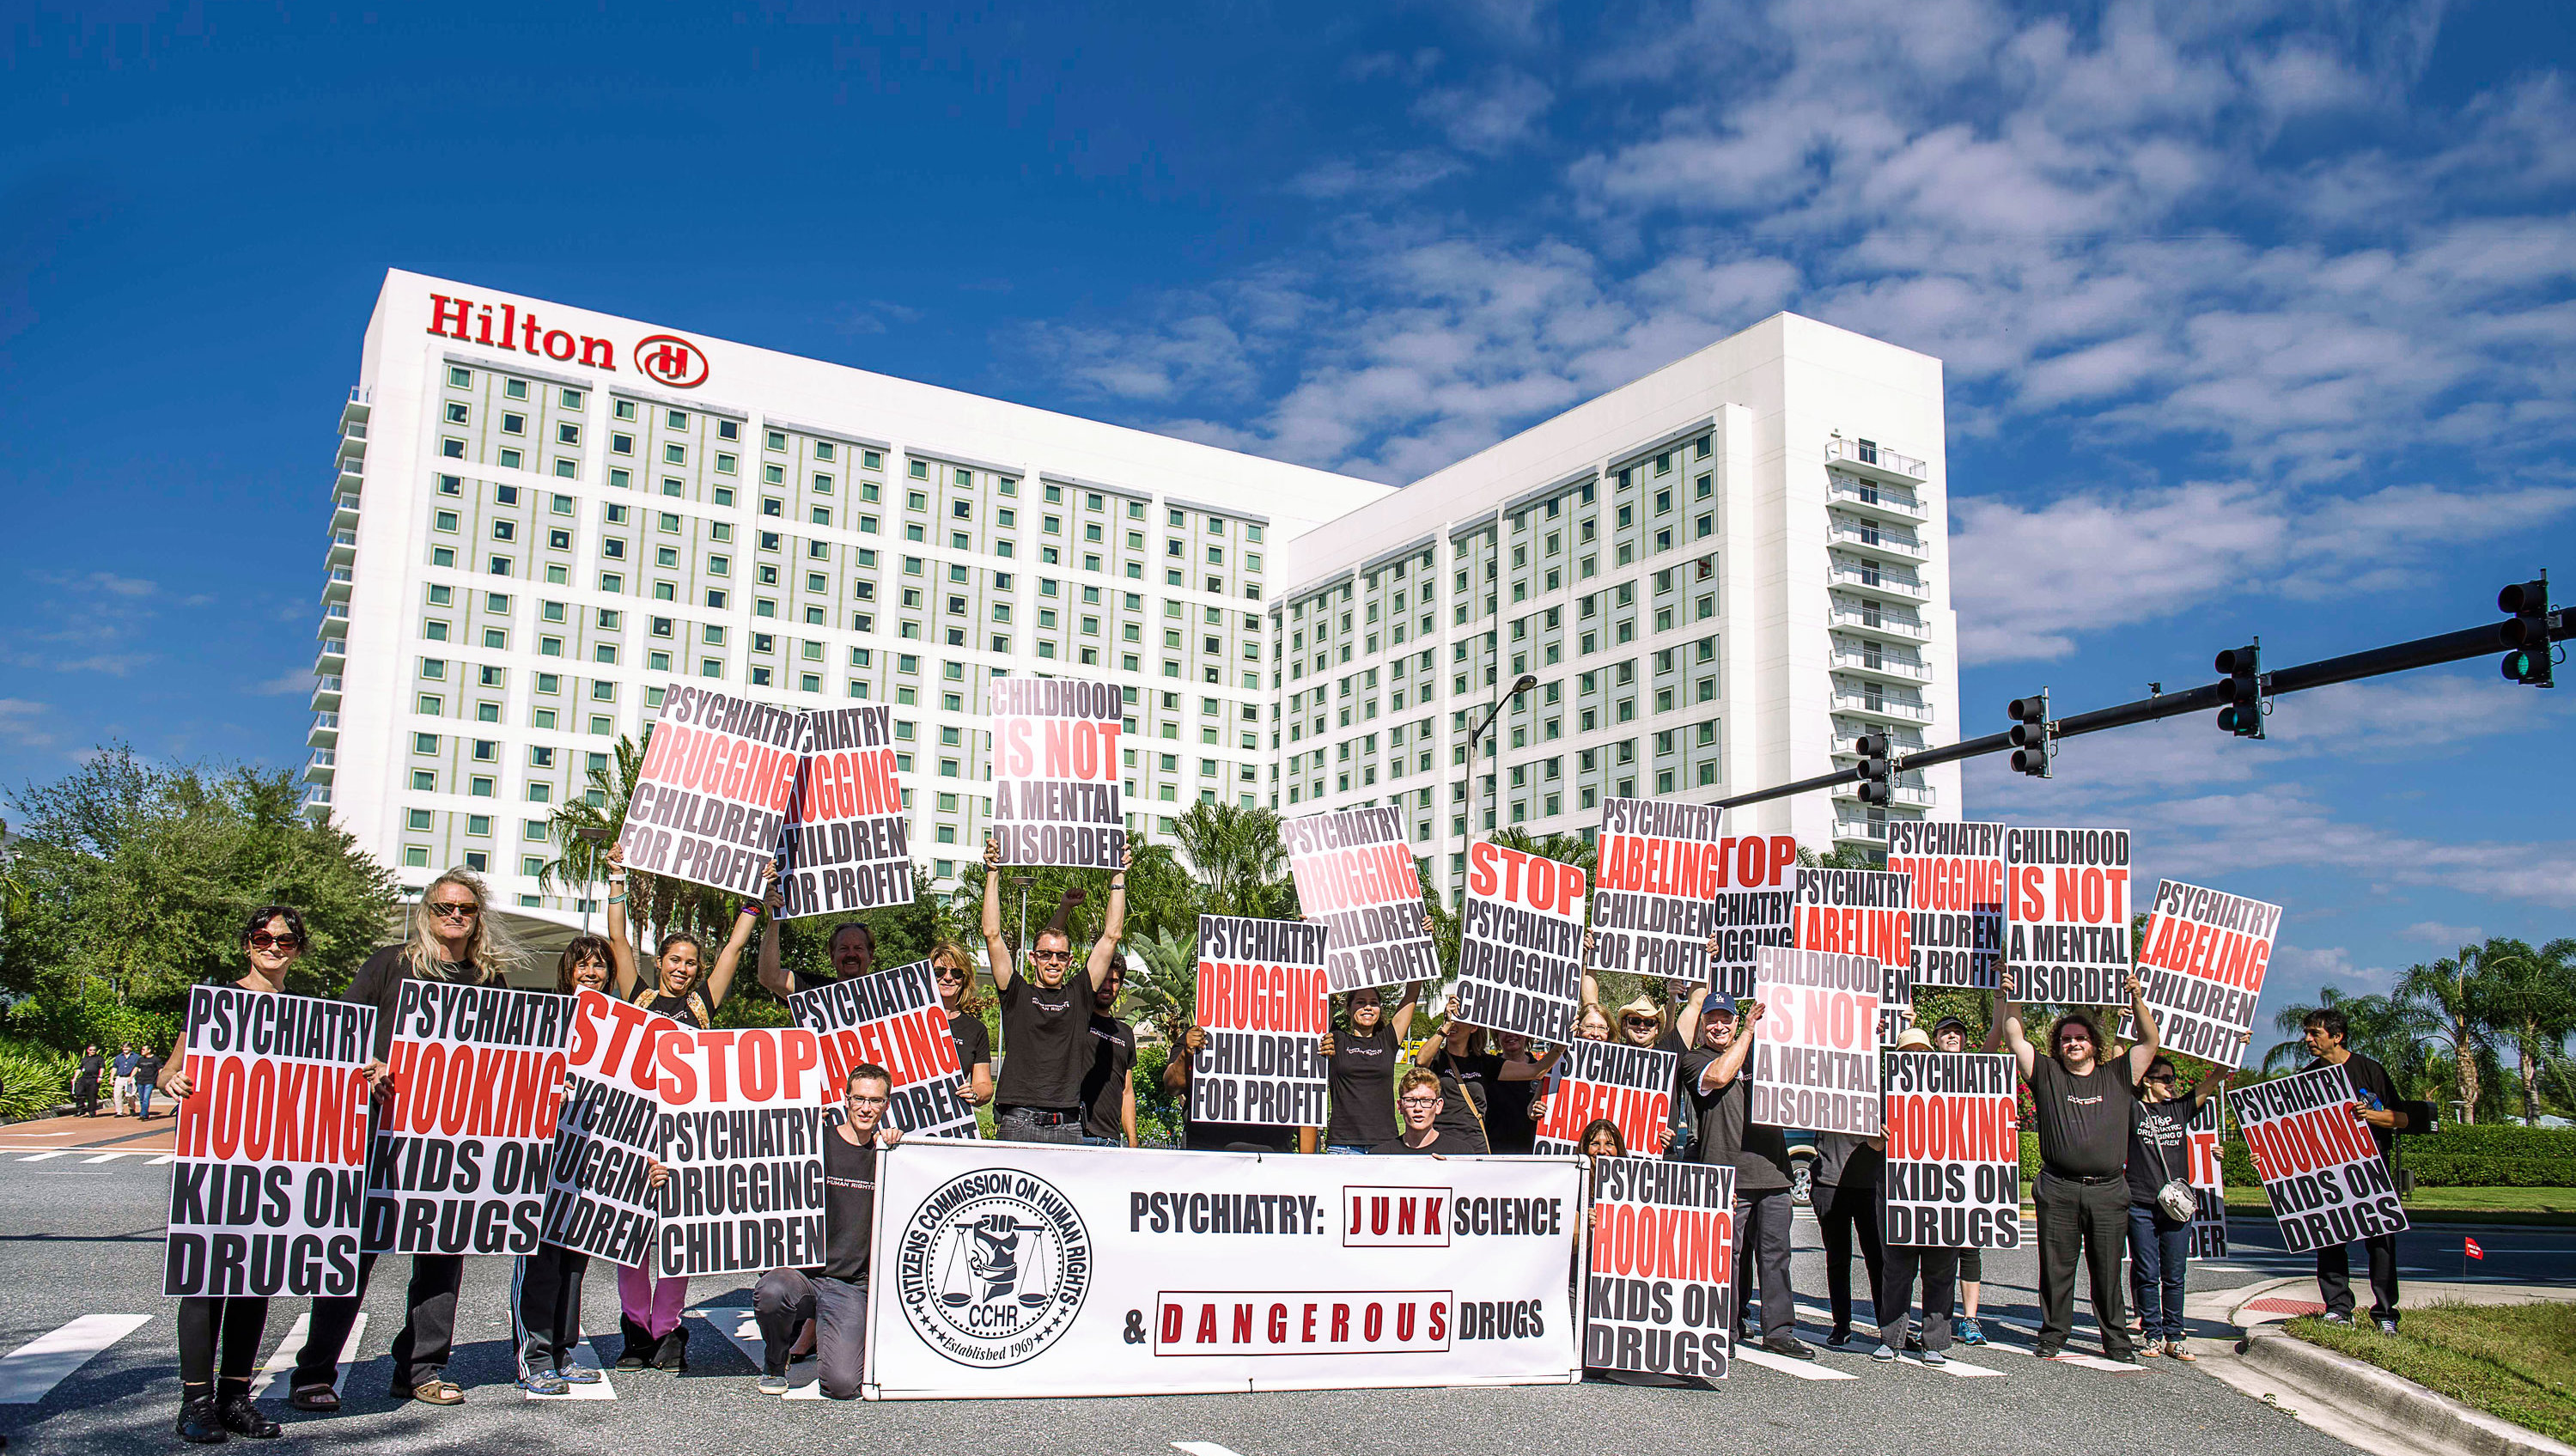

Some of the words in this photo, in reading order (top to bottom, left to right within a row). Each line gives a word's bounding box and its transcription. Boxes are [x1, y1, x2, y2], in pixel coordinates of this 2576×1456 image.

[427, 293, 616, 371] Hilton
[659, 683, 809, 752] PSYCHIATRY
[992, 679, 1122, 720] CHILDHOOD
[640, 722, 796, 811] DRUGGING
[994, 718, 1033, 777] IS
[1045, 720, 1122, 781] NOT
[783, 748, 902, 825] UGGING
[996, 780, 1014, 819] A
[1022, 781, 1123, 824] MENTAL
[629, 782, 783, 852] CHILDREN
[1287, 804, 1402, 856] PSYCHIATRY
[1602, 798, 1721, 841] PSYCHIATRY
[1889, 822, 2004, 856] PSYCHIATRY
[621, 822, 672, 870] FOR
[673, 835, 772, 895] PROFIT
[995, 825, 1125, 868] DISORDER
[1595, 834, 1718, 900] LABELING
[1717, 835, 1795, 888] TOP
[2007, 829, 2128, 866] CHILDHOOD
[823, 861, 910, 911] PROFIT
[1292, 843, 1421, 914] DRUGGING
[1471, 842, 1585, 917] STOP
[1796, 869, 1911, 909] PSYCHIATRY
[2009, 867, 2044, 923] IS
[2055, 868, 2128, 923] NOT
[1306, 902, 1430, 949] HILDREN
[1465, 898, 1583, 959] PSYCHIATRY
[1592, 892, 1714, 938] CHILDREN
[1715, 891, 1793, 927] CHIATRY
[2153, 880, 2280, 938] PSYCHIATRY
[1200, 917, 1328, 966] PSYCHIATRY
[1329, 953, 1361, 991] OR
[1361, 941, 1437, 985] PROFIT
[1460, 937, 1580, 1000] DRUGGING
[1589, 932, 1629, 969] FOR
[1635, 936, 1708, 979] PROFIT
[2010, 925, 2026, 961] A
[2033, 925, 2128, 964] MENTAL
[2137, 913, 2270, 992] LABELING
[789, 961, 936, 1033] PSYCHIATRY
[1197, 961, 1327, 1034] DRUGGING
[1757, 947, 1879, 993] CHILDHOOD
[2008, 966, 2129, 1003] DISORDER
[2134, 966, 2257, 1027] CHILDREN
[188, 995, 375, 1063] PSYCHIATRY
[395, 982, 578, 1048] PSYCHIATRY
[569, 990, 678, 1091] STO
[1457, 981, 1577, 1044] CHILDREN
[1757, 985, 1793, 1043] IS
[1804, 990, 1878, 1052] NOT
[2165, 1014, 2244, 1064] PROFIT
[657, 1029, 818, 1106] STOP
[1195, 1032, 1326, 1079] CHILDREN
[1560, 1040, 1675, 1092] SYCHIATRY
[1757, 1044, 1774, 1081] A
[1781, 1045, 1878, 1093] MENTAL
[1887, 1053, 2016, 1094] PSYCHIATRY
[177, 1055, 368, 1167] HOOKING
[379, 1040, 576, 1140] HOOKING
[1195, 1078, 1237, 1121] FOR
[1245, 1081, 1326, 1124] PROFIT
[1753, 1085, 1879, 1134] DISORDER
[2232, 1067, 2354, 1124] PSYCHIATRY
[660, 1107, 819, 1162] PSYCHIATRY
[1886, 1094, 2017, 1163] HOOKING
[2137, 1128, 2176, 1141] DRUGING
[2243, 1101, 2378, 1182] HOOKING
[369, 1136, 484, 1193] KIDS
[492, 1139, 553, 1195] ON
[661, 1160, 823, 1218] DRUGGING
[1015, 1178, 1041, 1202] ON
[1596, 1158, 1733, 1209] PSYCHIATRY
[1887, 1162, 1965, 1203] KIDS
[1976, 1165, 2017, 1203] ON
[2265, 1170, 2344, 1216] KIDS
[2344, 1158, 2393, 1198] ON
[172, 1163, 292, 1228] KIDS
[303, 1168, 362, 1228] ON
[918, 1173, 1012, 1229] COMMISSION
[1037, 1189, 1083, 1244] HUMAN
[1130, 1191, 1325, 1235] PSYCHIATRY:
[1350, 1196, 1444, 1235] JUNK
[1453, 1197, 1561, 1236] SCIENCE
[362, 1196, 541, 1254] DRUGS
[540, 1186, 655, 1265] ILDREN
[662, 1215, 825, 1276] CHILDREN
[1592, 1203, 1732, 1284] HOOKING
[1888, 1205, 2019, 1248] DRUGS
[2280, 1196, 2407, 1253] DRUGS
[164, 1233, 357, 1295] DRUGS
[902, 1229, 929, 1305] CITIZENS
[1059, 1245, 1087, 1306] RIGHTS
[969, 1305, 1018, 1327] CCHR
[1123, 1309, 1147, 1344] &
[1161, 1302, 1447, 1343] DANGEROUS
[1459, 1299, 1544, 1341] DRUGS
[1590, 1276, 1673, 1325] KIDS
[1683, 1284, 1728, 1330] ON
[942, 1337, 1006, 1361] Established
[1010, 1337, 1033, 1357] 1969
[1587, 1324, 1726, 1375] DRUGS
